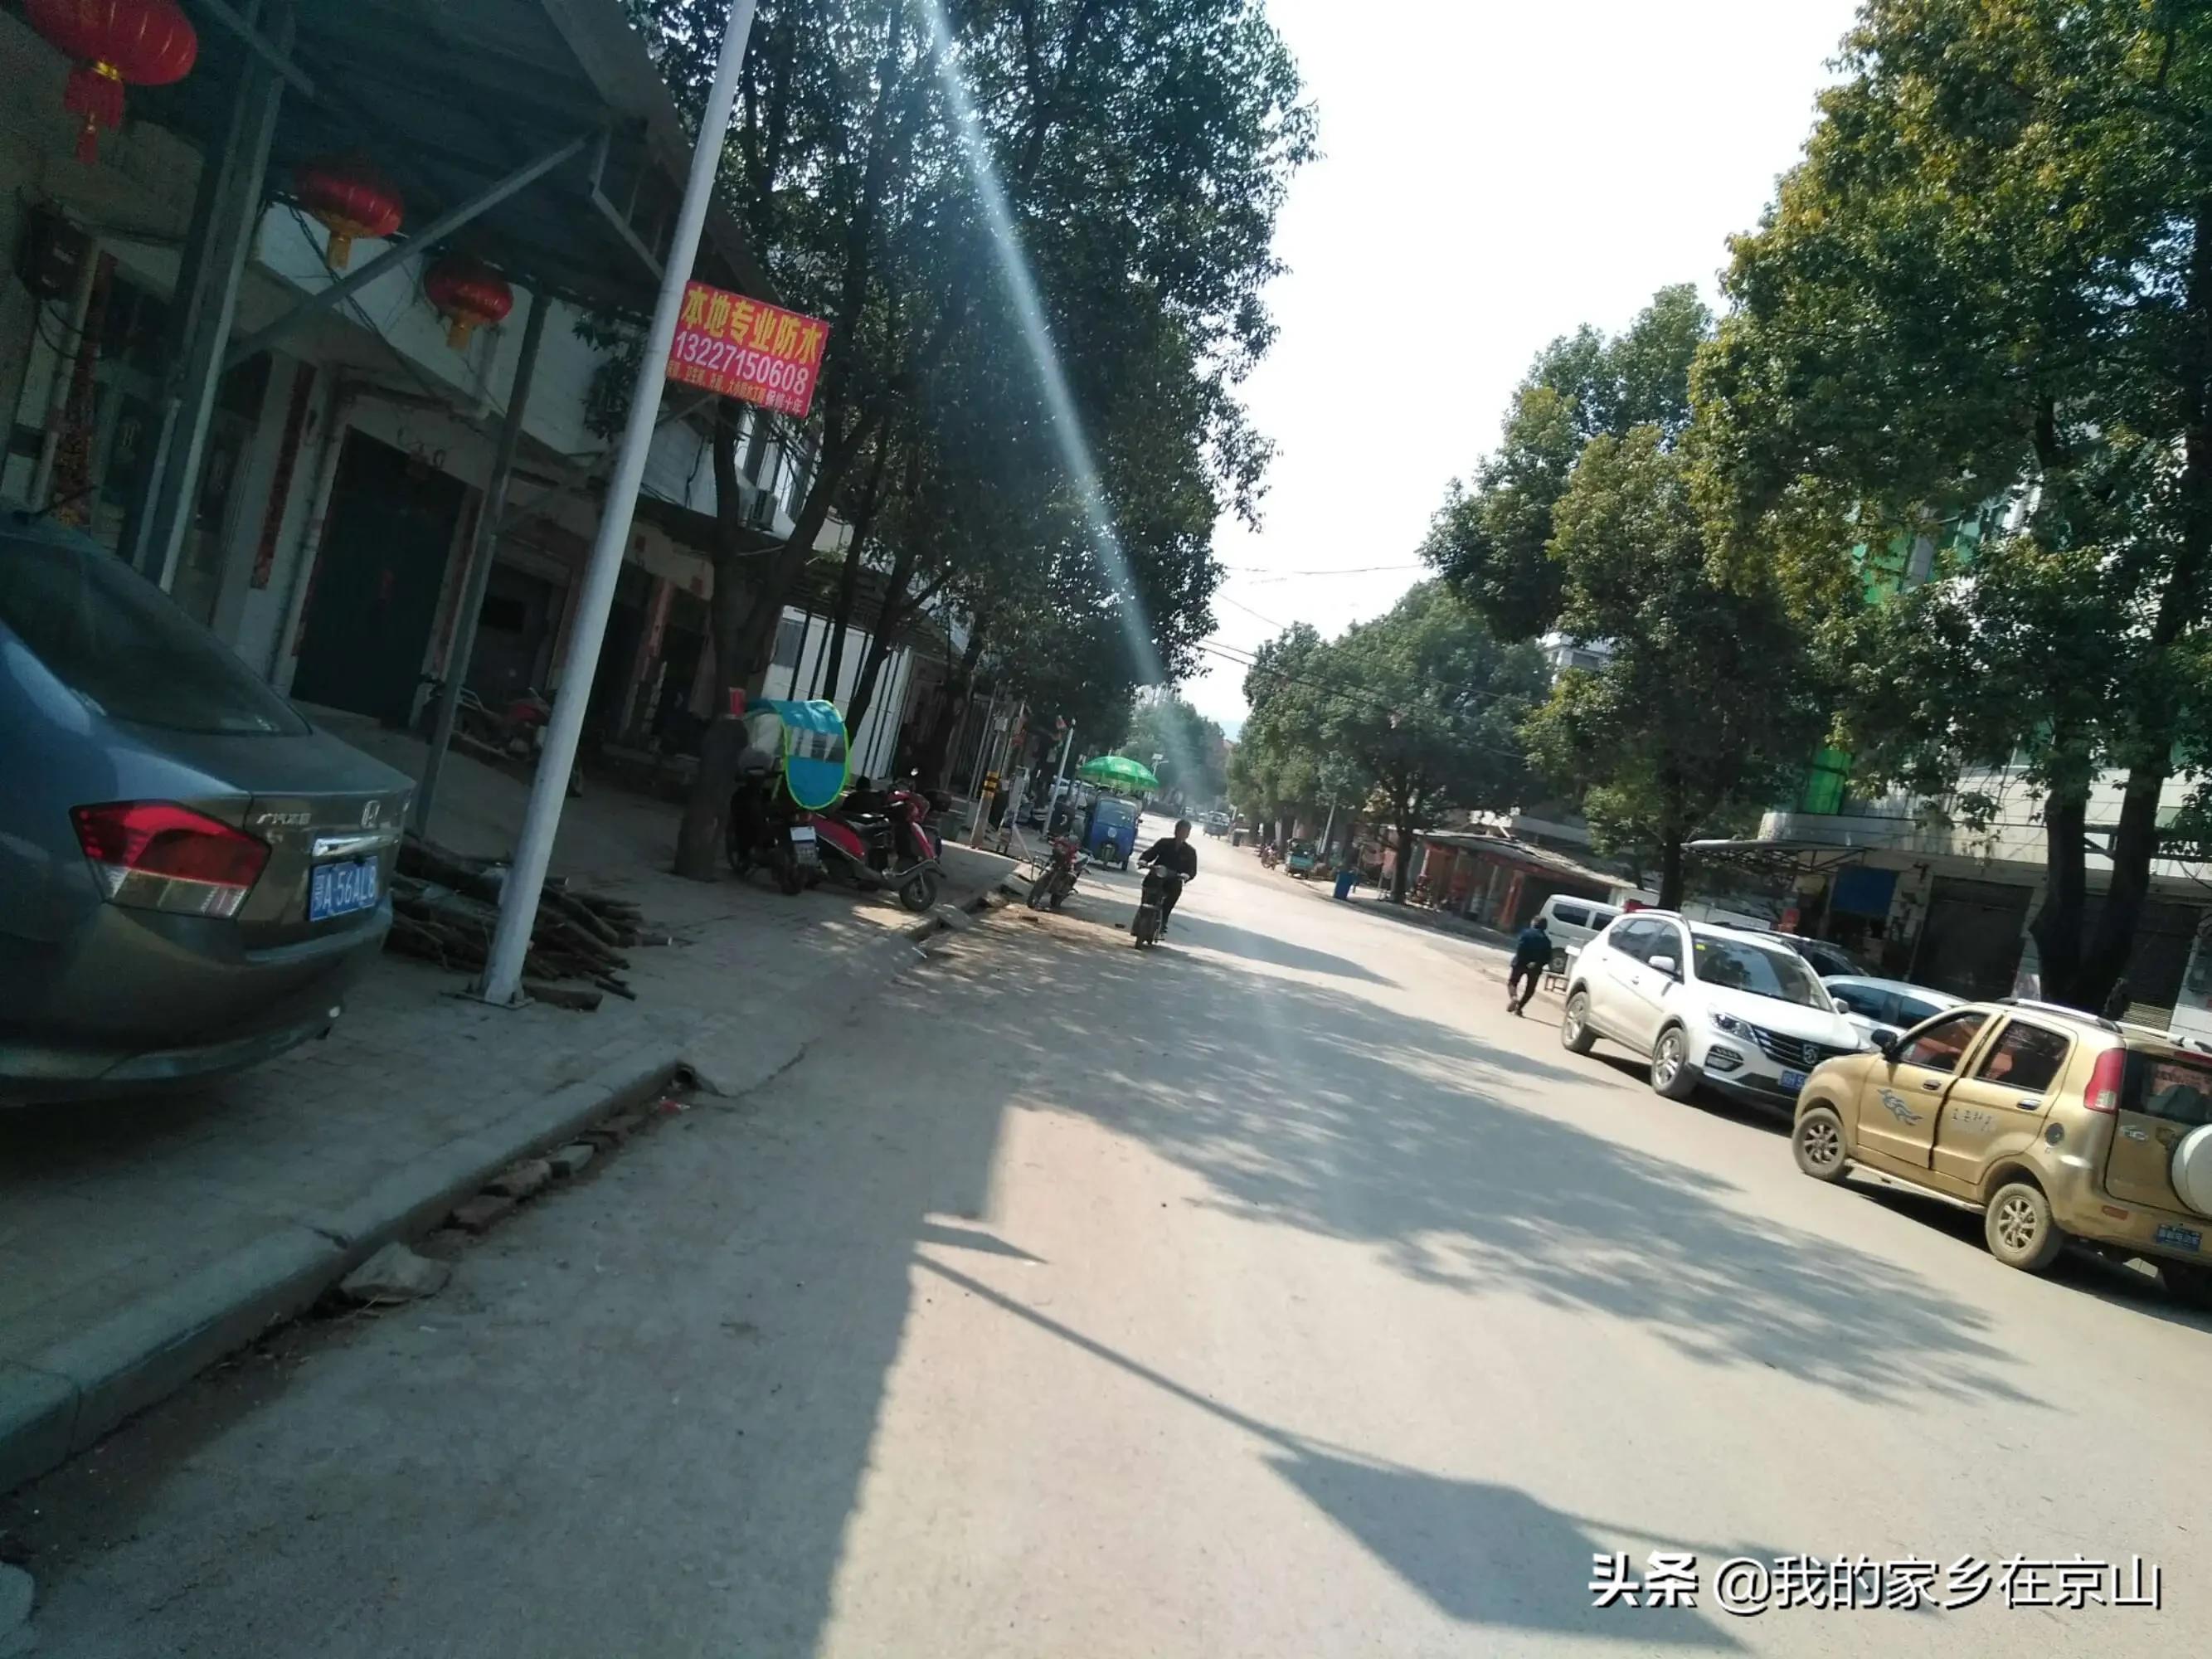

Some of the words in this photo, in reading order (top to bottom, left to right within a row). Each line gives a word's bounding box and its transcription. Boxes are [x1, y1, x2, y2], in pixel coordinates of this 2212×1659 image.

[681, 286, 823, 365] 本地专业防水
[676, 330, 809, 395] 13227150608
